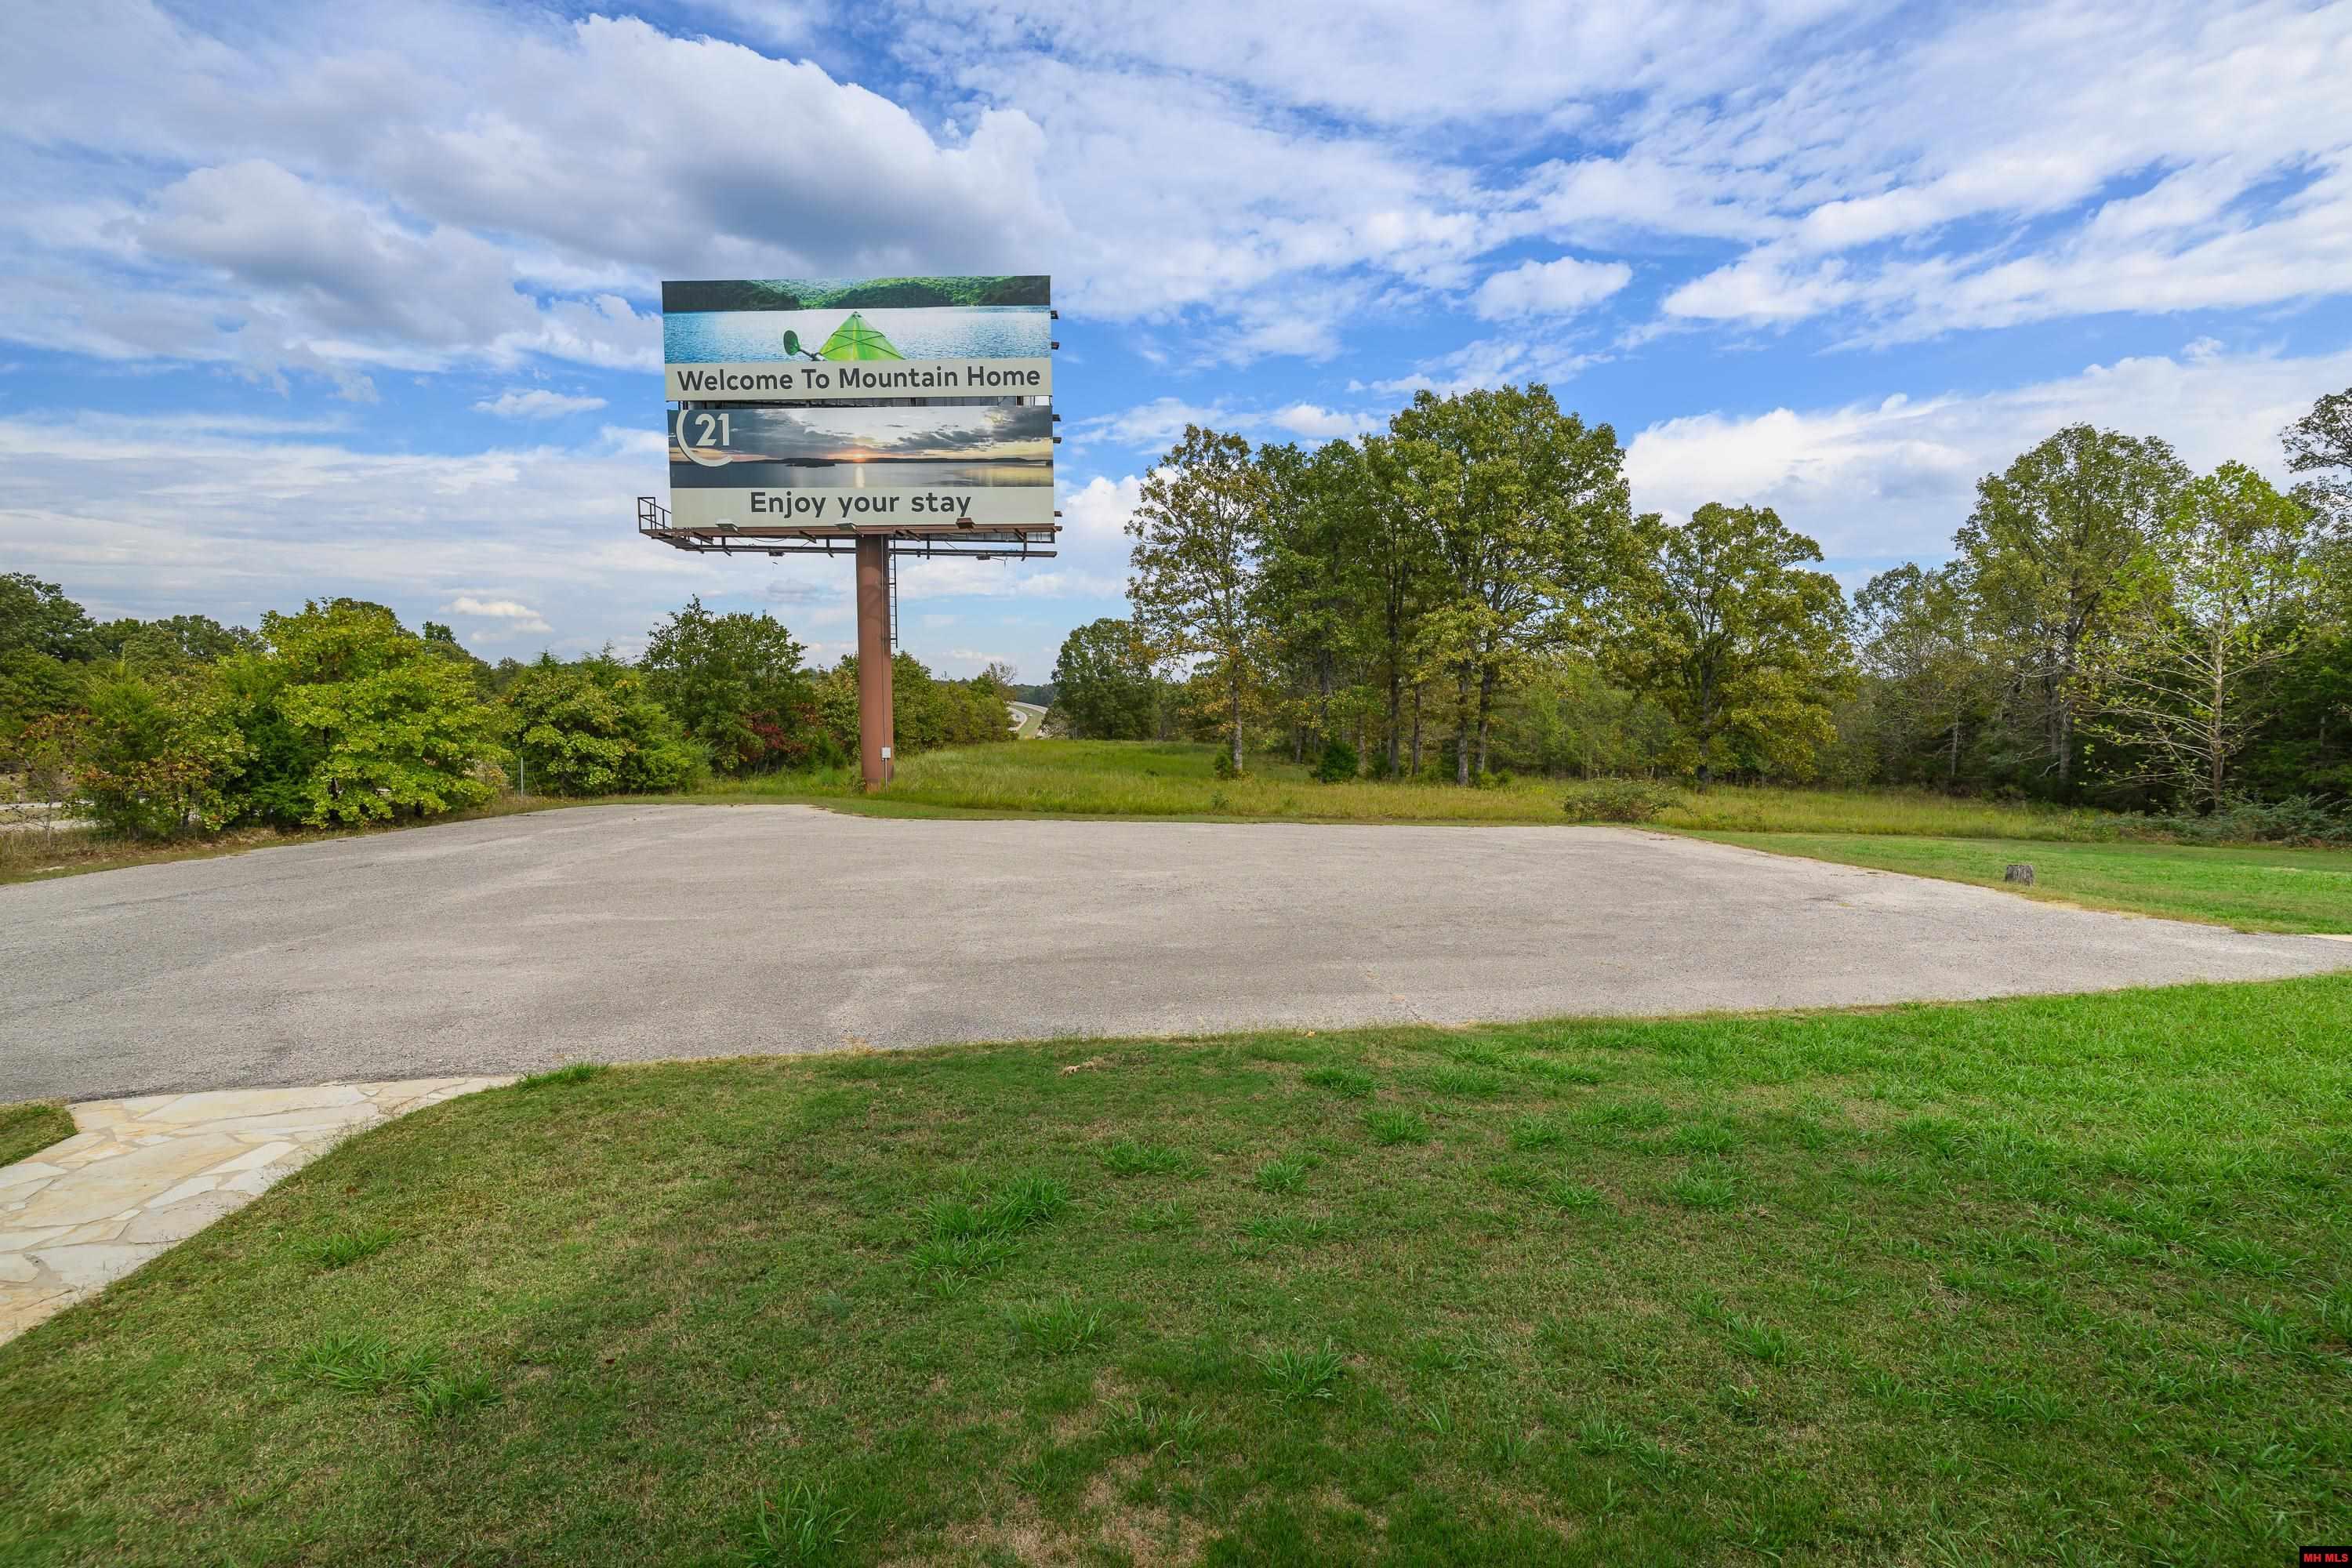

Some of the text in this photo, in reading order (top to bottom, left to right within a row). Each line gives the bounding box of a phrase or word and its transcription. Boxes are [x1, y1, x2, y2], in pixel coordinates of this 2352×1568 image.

[677, 365, 1041, 391] Welcome To Mountain Home
[750, 492, 971, 518] Enjoy your stay
